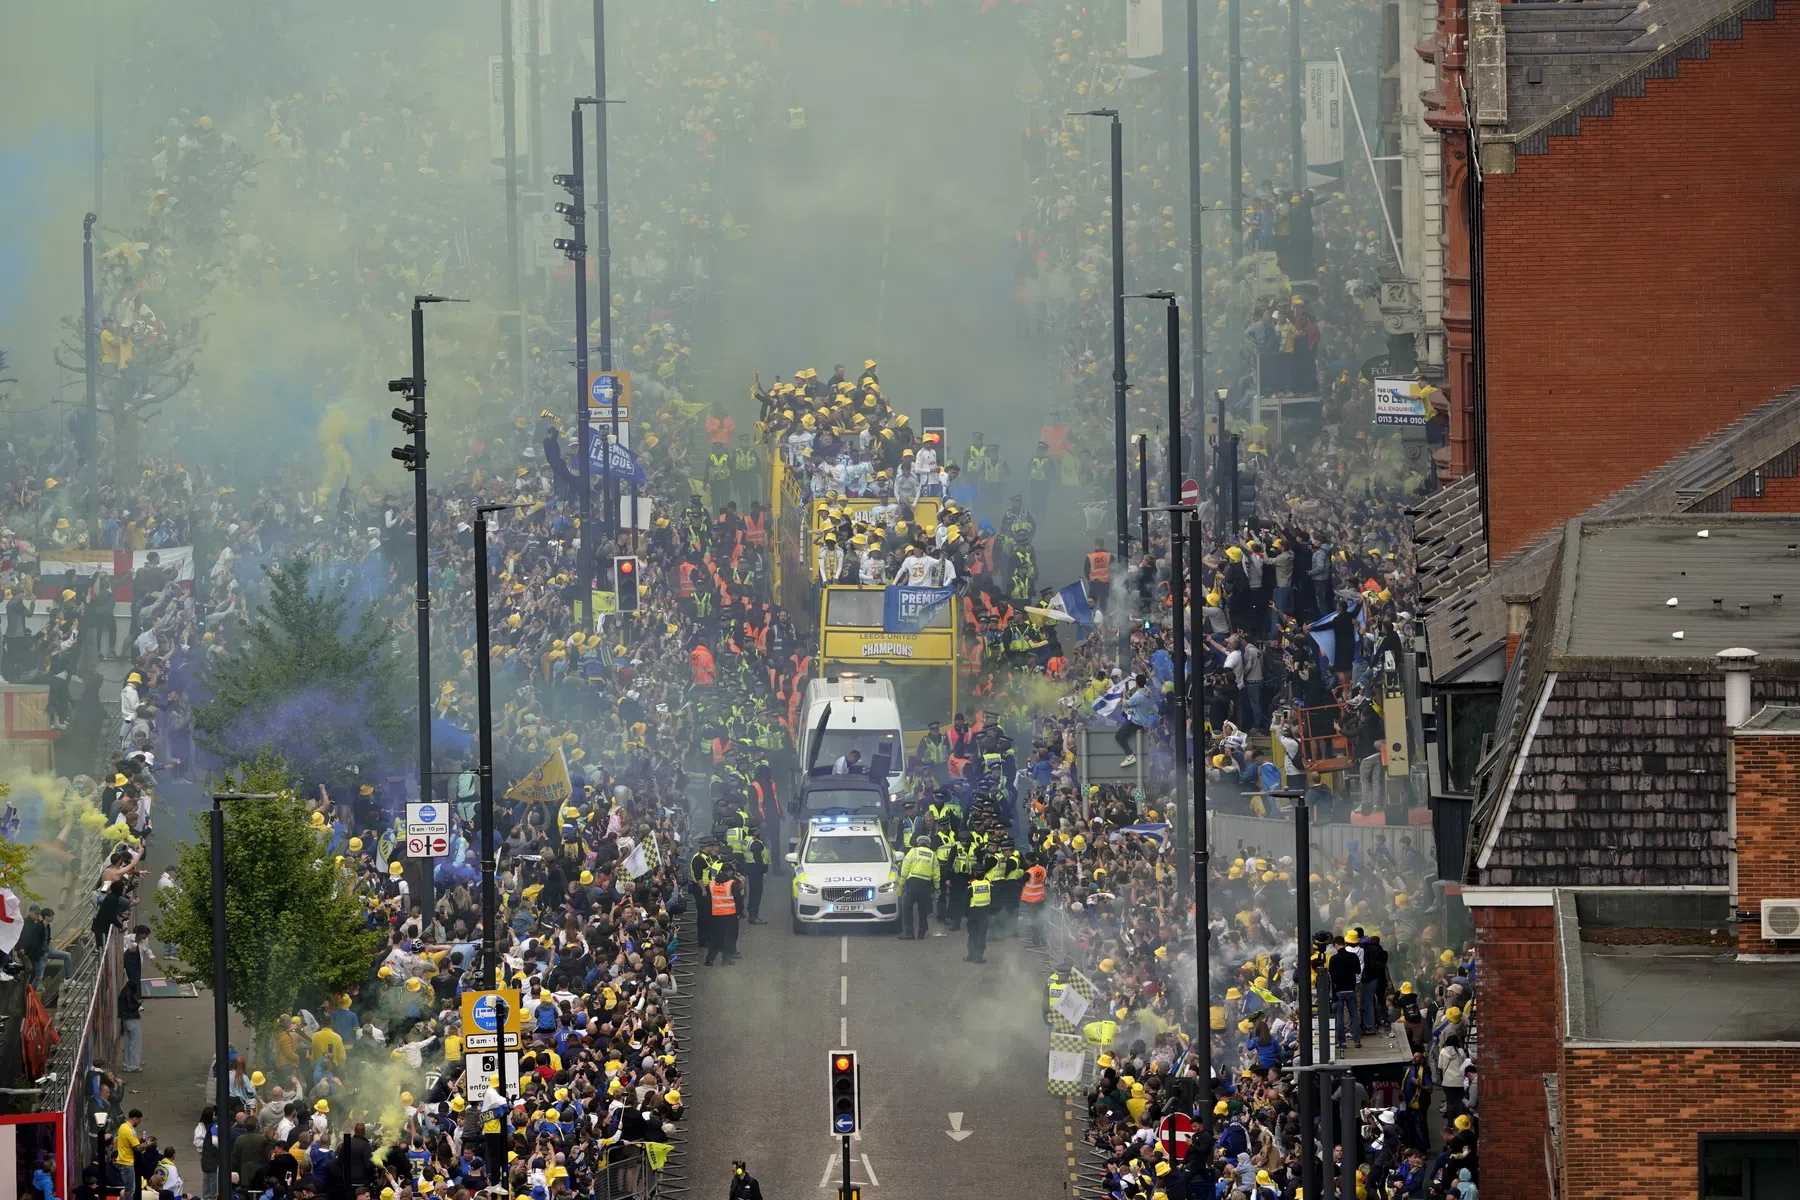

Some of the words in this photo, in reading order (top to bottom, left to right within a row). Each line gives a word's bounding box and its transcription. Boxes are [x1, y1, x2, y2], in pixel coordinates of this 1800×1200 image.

[1377, 395, 1389, 403] TO
[590, 447, 632, 470] LEGUE
[912, 567, 925, 577] 25
[901, 593, 941, 604] PREMI
[862, 643, 913, 657] CHAMPIONS
[425, 1075, 439, 1090] 17
